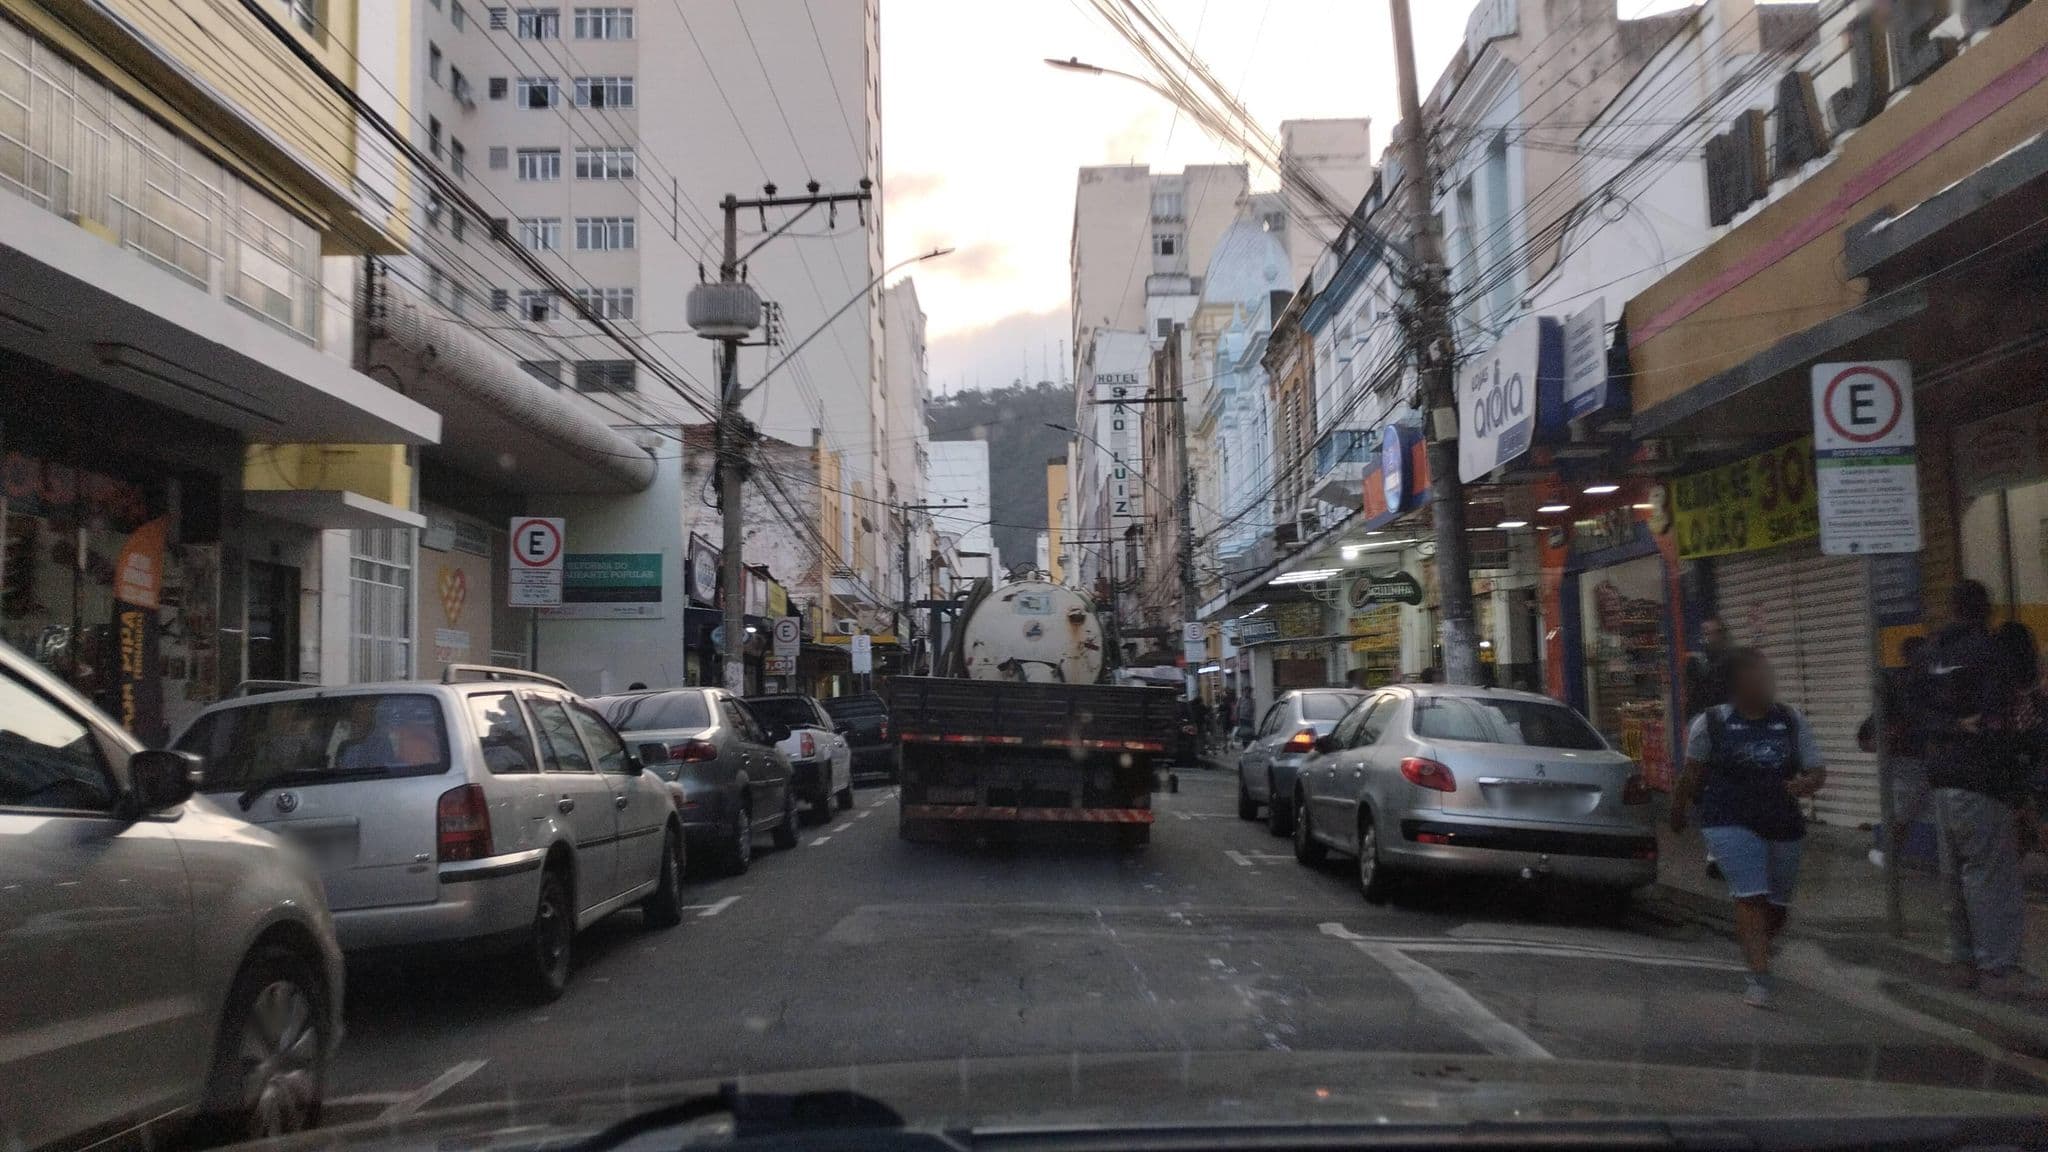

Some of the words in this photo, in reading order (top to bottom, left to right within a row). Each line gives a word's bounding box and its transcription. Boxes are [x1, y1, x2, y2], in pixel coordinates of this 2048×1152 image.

[1097, 374, 1138, 385] HOTEL
[1849, 383, 1877, 426] E
[1114, 452, 1128, 513] LUIZ
[529, 530, 546, 556] E
[611, 570, 655, 580] POPULAR
[782, 625, 791, 638] E
